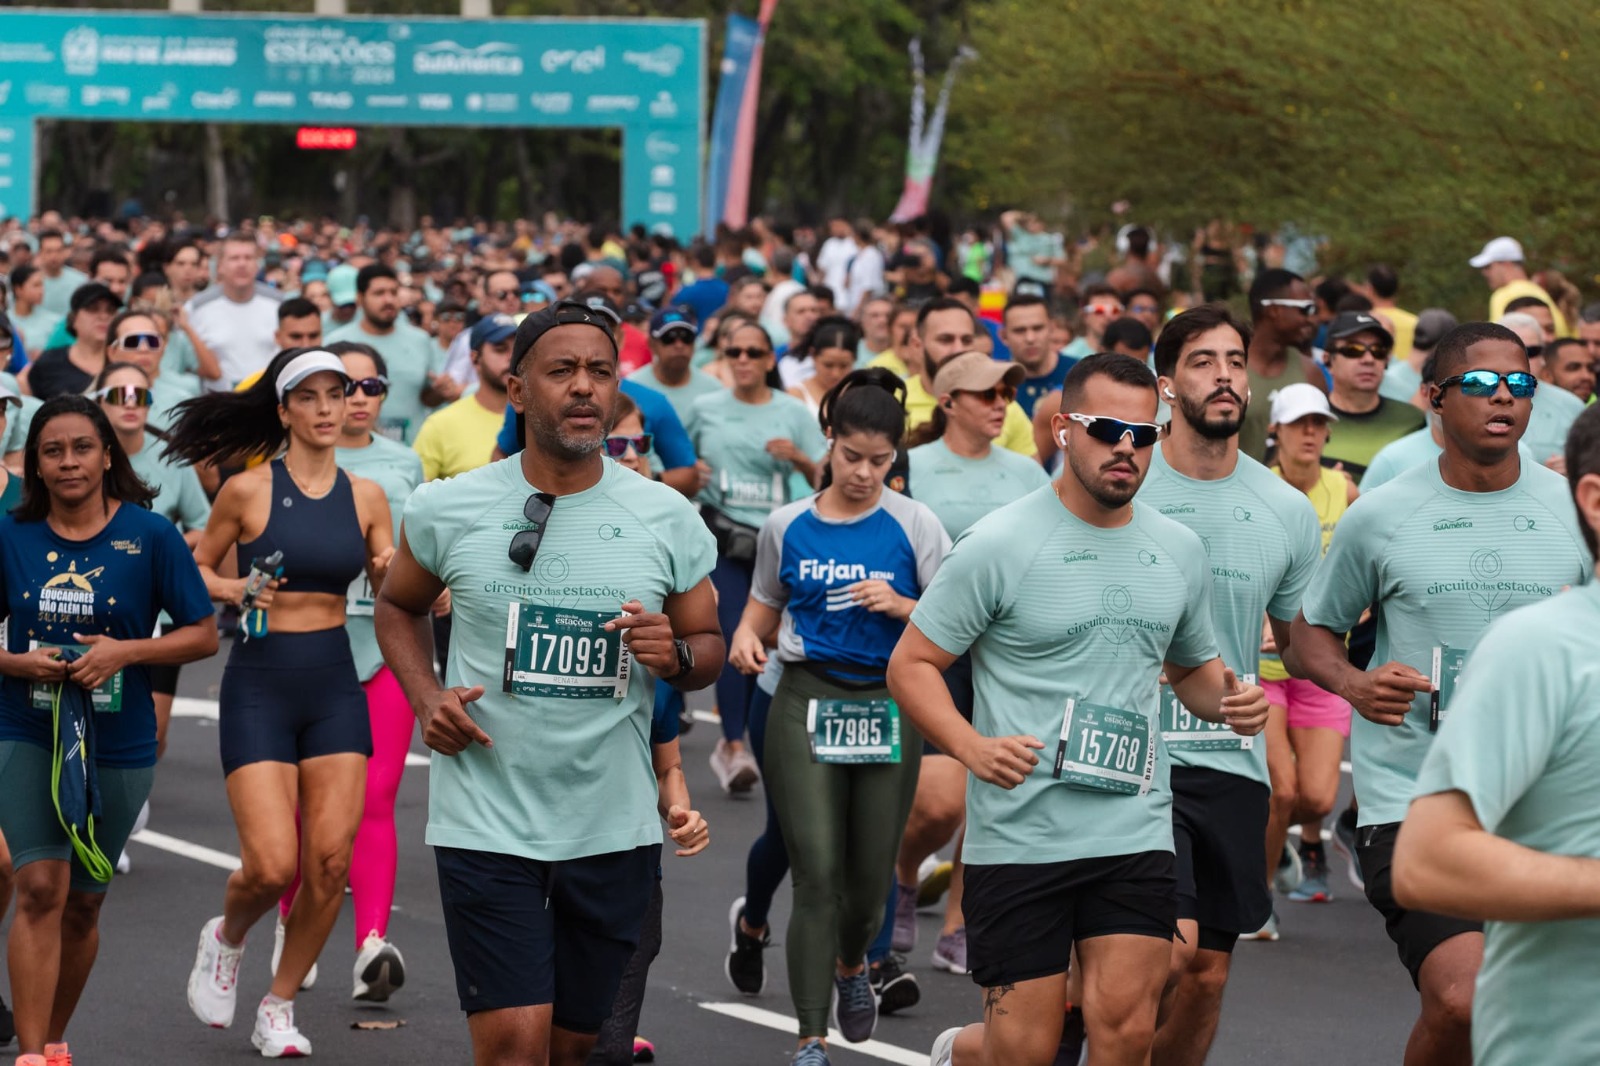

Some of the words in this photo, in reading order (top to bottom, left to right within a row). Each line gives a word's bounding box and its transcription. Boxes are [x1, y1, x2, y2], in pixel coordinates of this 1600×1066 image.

[264, 37, 395, 66] estações
[413, 51, 524, 76] SulAmérica
[1433, 521, 1473, 532] SulAmérica
[1063, 553, 1098, 564] SulAmérica
[799, 558, 867, 585] Firjan
[869, 570, 895, 581] SENAI
[1211, 566, 1251, 582] stações
[40, 588, 95, 604] EDUCADORES
[484, 581, 543, 597] circuito
[544, 587, 561, 596] das
[563, 586, 627, 600] estações
[1427, 579, 1479, 596] circuito
[1480, 582, 1496, 591] das
[1497, 581, 1553, 596] estações
[39, 598, 57, 613] VÃO
[57, 601, 81, 615] ALÉM
[82, 604, 94, 616] DA
[555, 617, 593, 628] estações
[1067, 615, 1110, 637] circuito
[1111, 616, 1125, 626] das
[1126, 616, 1171, 634] estações
[530, 632, 608, 676] 17093
[553, 676, 580, 685] RENATA
[824, 718, 882, 746] 17985
[891, 717, 900, 746] VERDE
[1078, 727, 1141, 772] 15768
[1144, 737, 1154, 781] BRANCO
